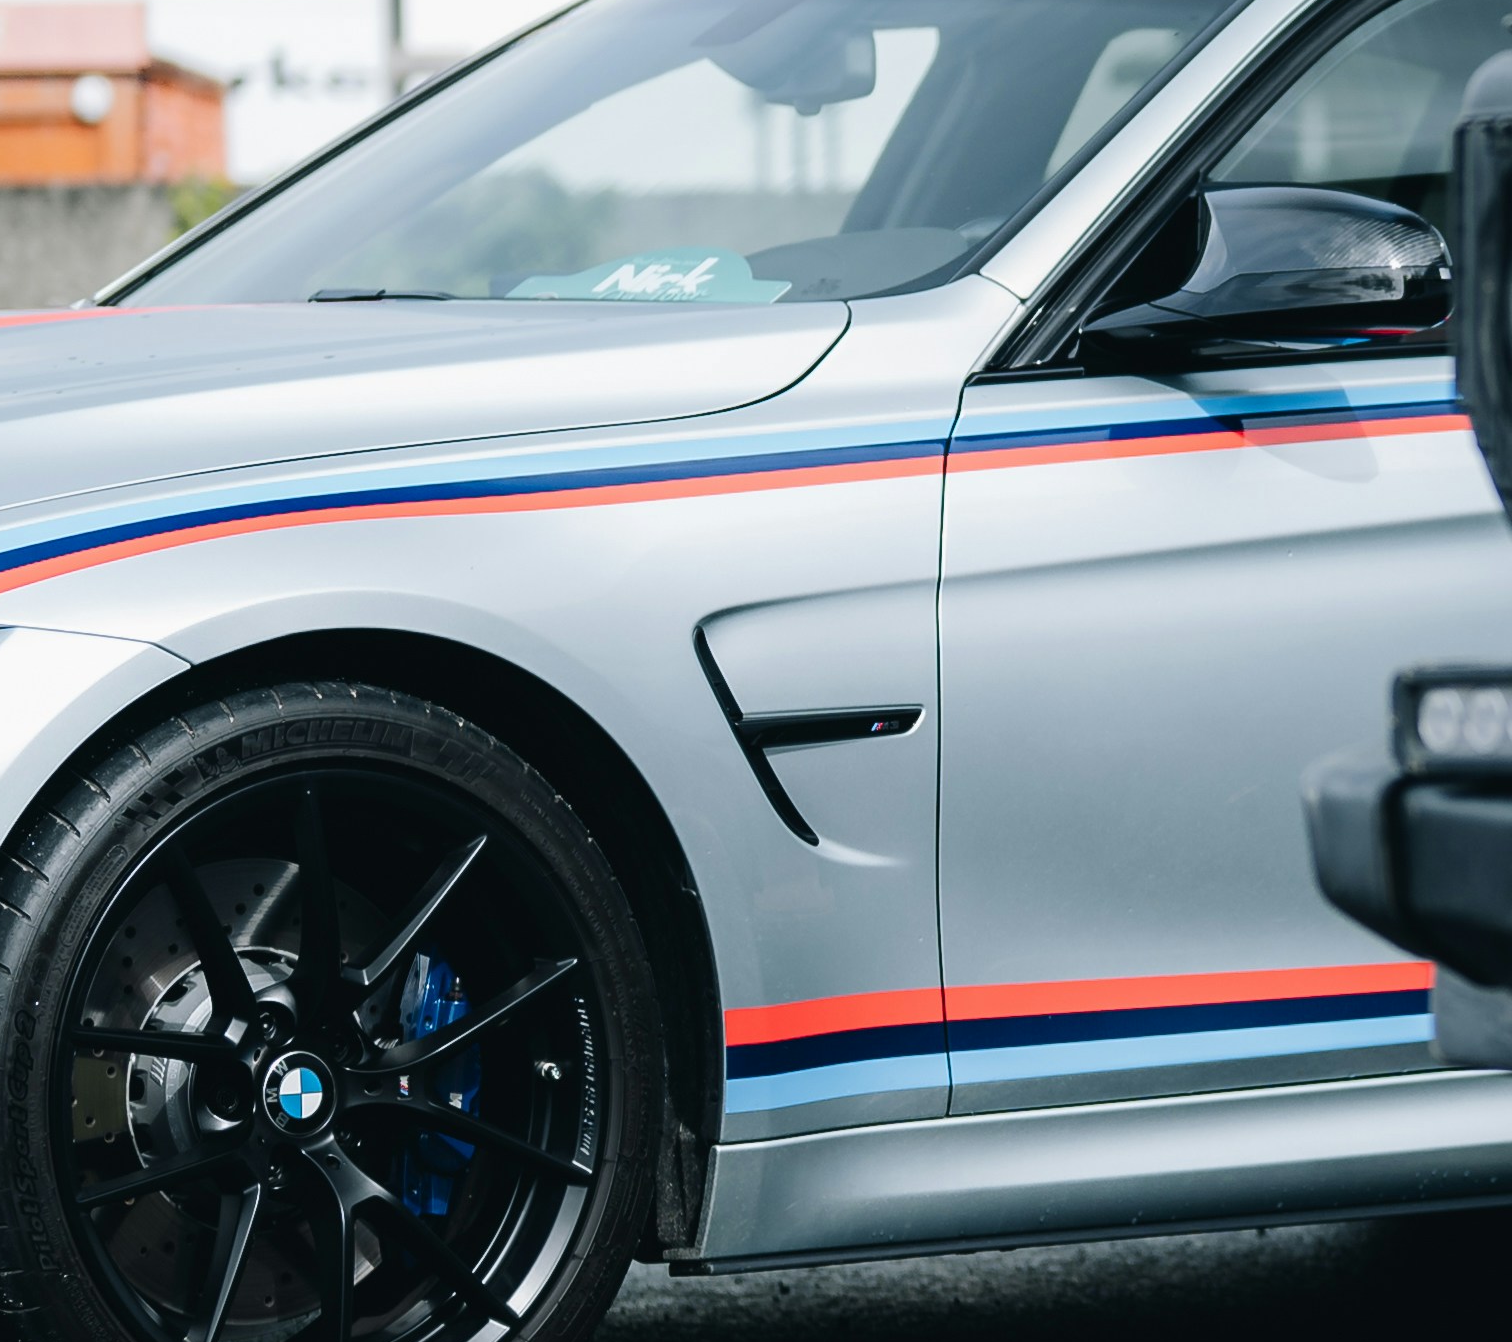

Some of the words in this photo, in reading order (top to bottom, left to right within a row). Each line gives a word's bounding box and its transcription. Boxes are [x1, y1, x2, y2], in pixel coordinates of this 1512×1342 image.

[241, 719, 412, 759] MICHELIN
[14, 1009, 37, 1040] 2
[7, 1041, 35, 1101] Cup
[265, 1058, 290, 1128] BMW
[8, 1103, 39, 1196] Sport
[22, 1199, 59, 1272] Pilot
